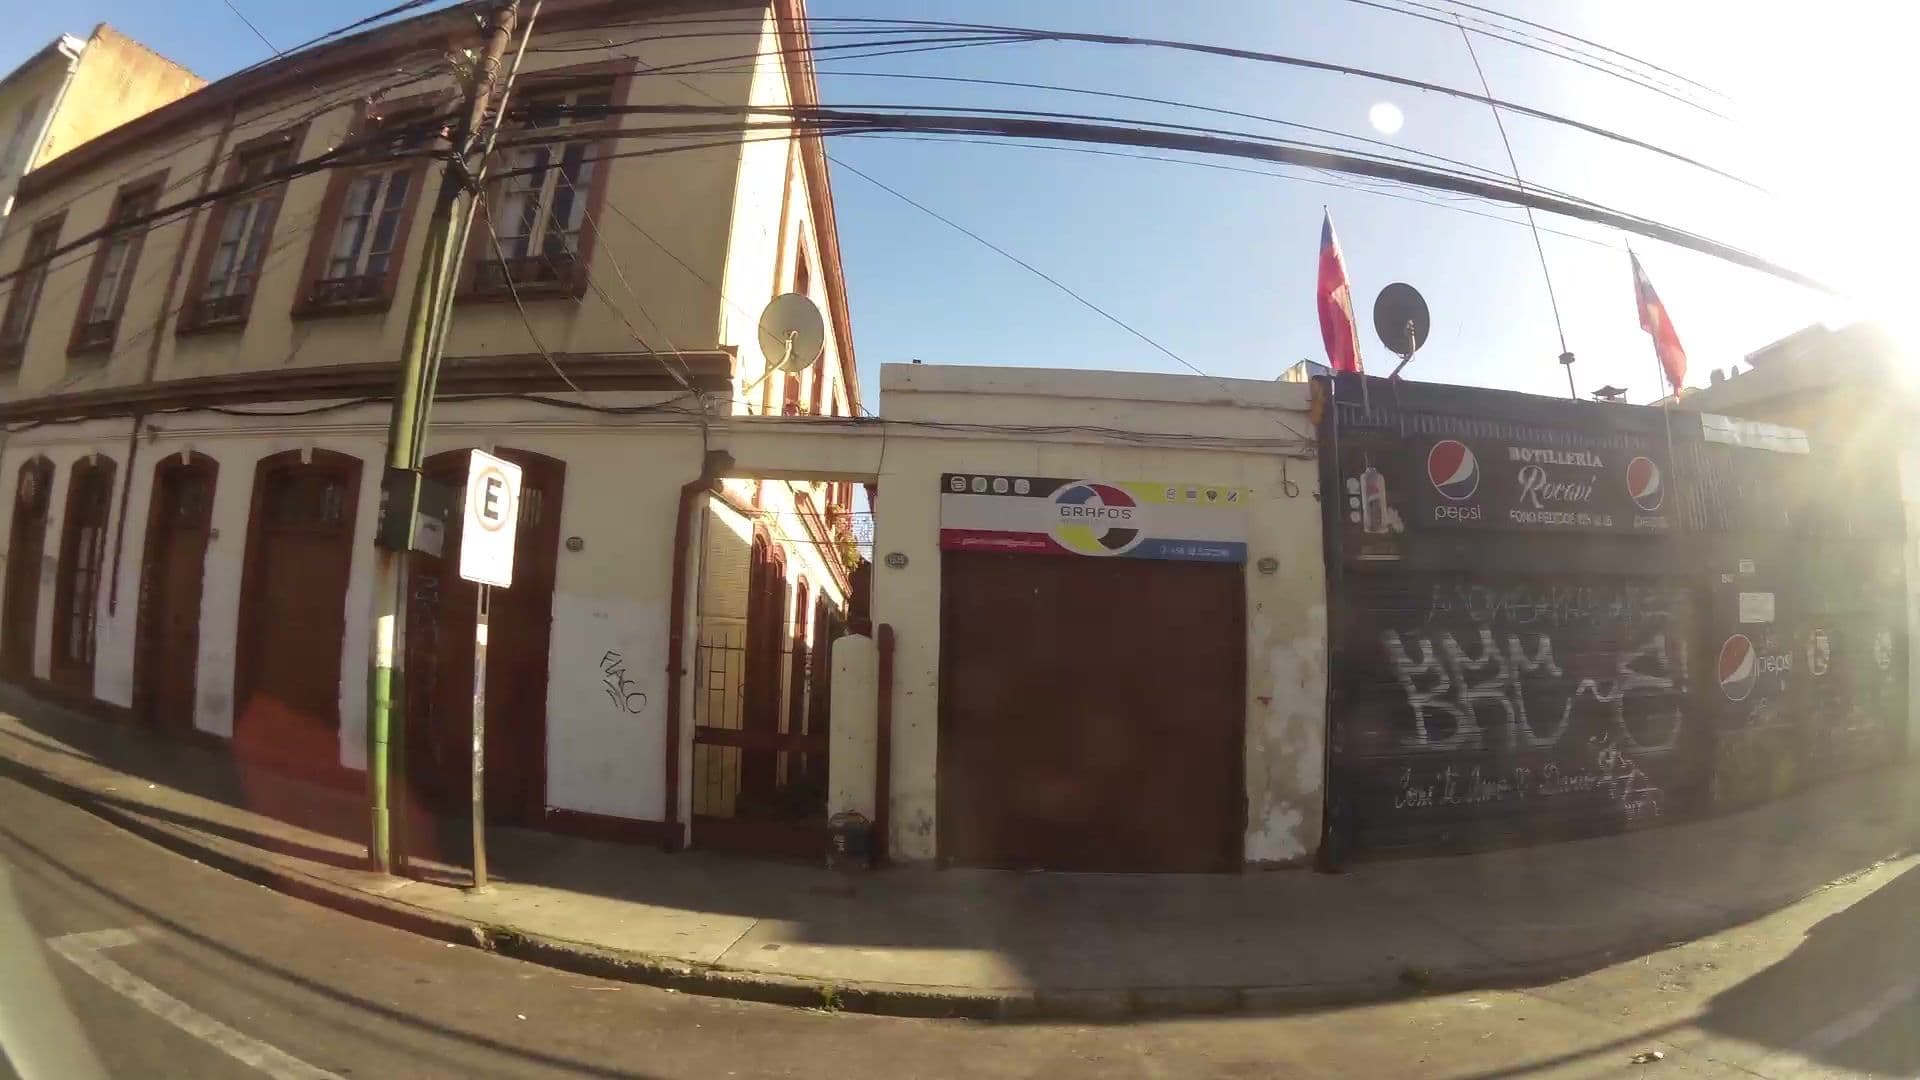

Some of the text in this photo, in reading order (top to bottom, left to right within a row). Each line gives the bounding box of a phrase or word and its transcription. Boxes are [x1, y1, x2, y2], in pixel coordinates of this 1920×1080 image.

[484, 477, 502, 520] E
[1060, 505, 1132, 520] GRAFOS
[1434, 503, 1482, 523] pepsi
